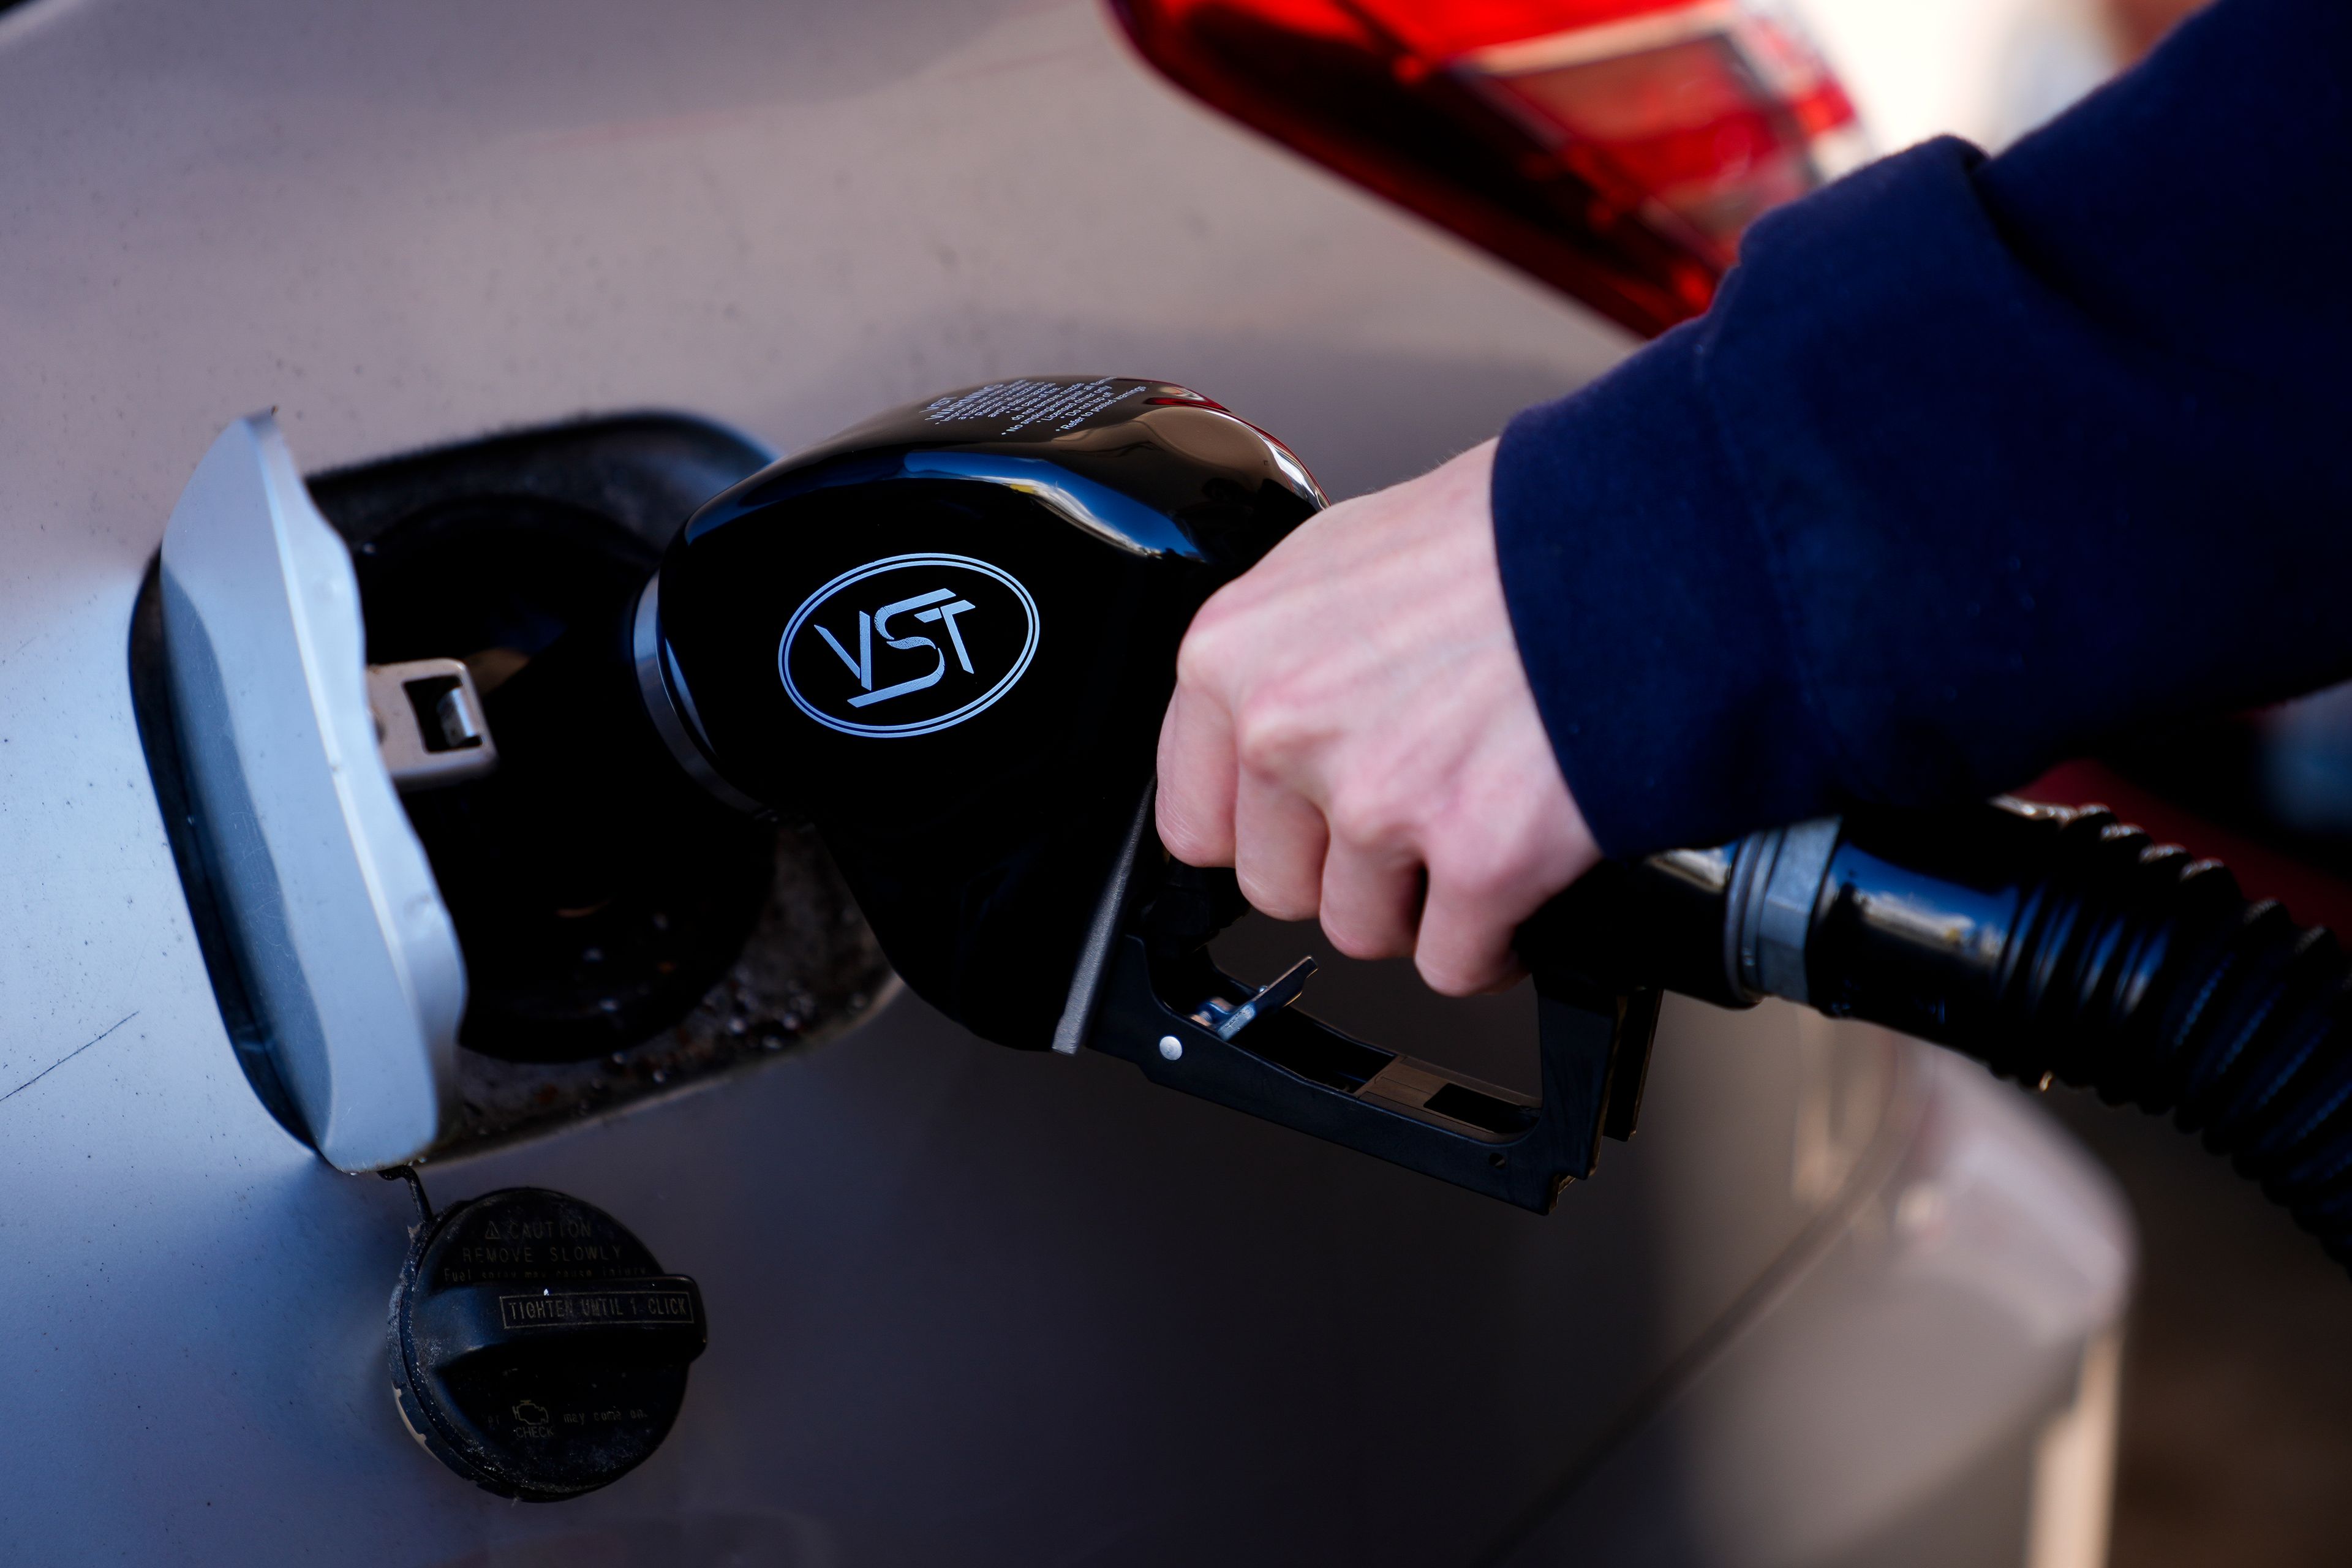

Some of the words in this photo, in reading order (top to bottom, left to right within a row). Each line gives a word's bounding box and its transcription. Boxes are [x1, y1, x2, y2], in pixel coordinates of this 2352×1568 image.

[924, 384, 1004, 420] WARNING
[1021, 398, 1041, 407] case
[1034, 394, 1062, 409] remove
[1060, 382, 1085, 395] nozzle
[1041, 402, 1077, 421] Licensed
[1074, 391, 1096, 404] driver
[1094, 385, 1112, 394] only
[919, 397, 957, 413] VST
[974, 401, 1007, 416] Remain
[988, 405, 1009, 417] avoid
[1060, 416, 1085, 430] Refer
[1091, 399, 1117, 412] posted
[1112, 385, 1146, 401] warnings
[814, 588, 976, 708] VST
[509, 1217, 592, 1239] CAUTION
[462, 1247, 534, 1263] REMOVE
[549, 1245, 622, 1262] SLOWLY
[444, 1268, 471, 1282] Fuel
[509, 1299, 573, 1320] TIGHTEN
[581, 1297, 623, 1317] UNTIL
[630, 1297, 638, 1315] 1
[647, 1297, 687, 1315] CLICK
[563, 1412, 585, 1426] may
[593, 1410, 622, 1422] come
[515, 1426, 554, 1438] CHECK
